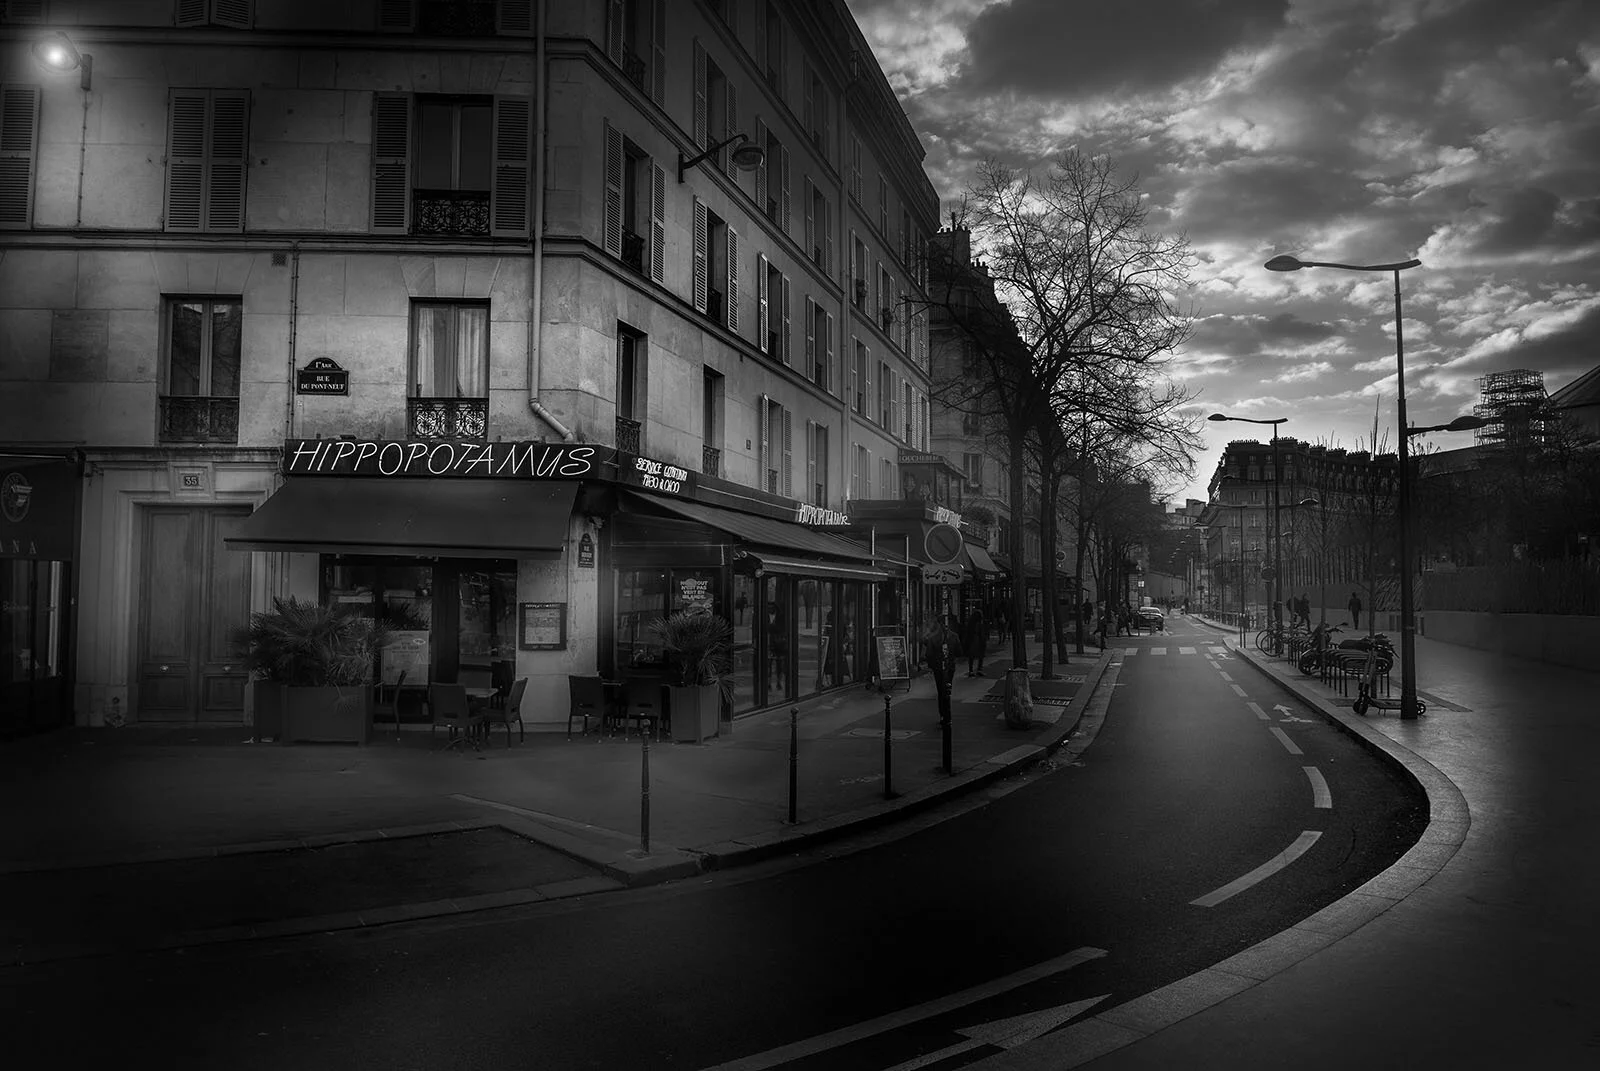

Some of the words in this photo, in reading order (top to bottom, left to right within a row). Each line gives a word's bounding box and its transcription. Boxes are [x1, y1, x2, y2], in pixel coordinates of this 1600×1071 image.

[289, 441, 596, 478] HIPPOPOTAMUS
[635, 457, 662, 474] SERVICE
[185, 476, 198, 485] 35
